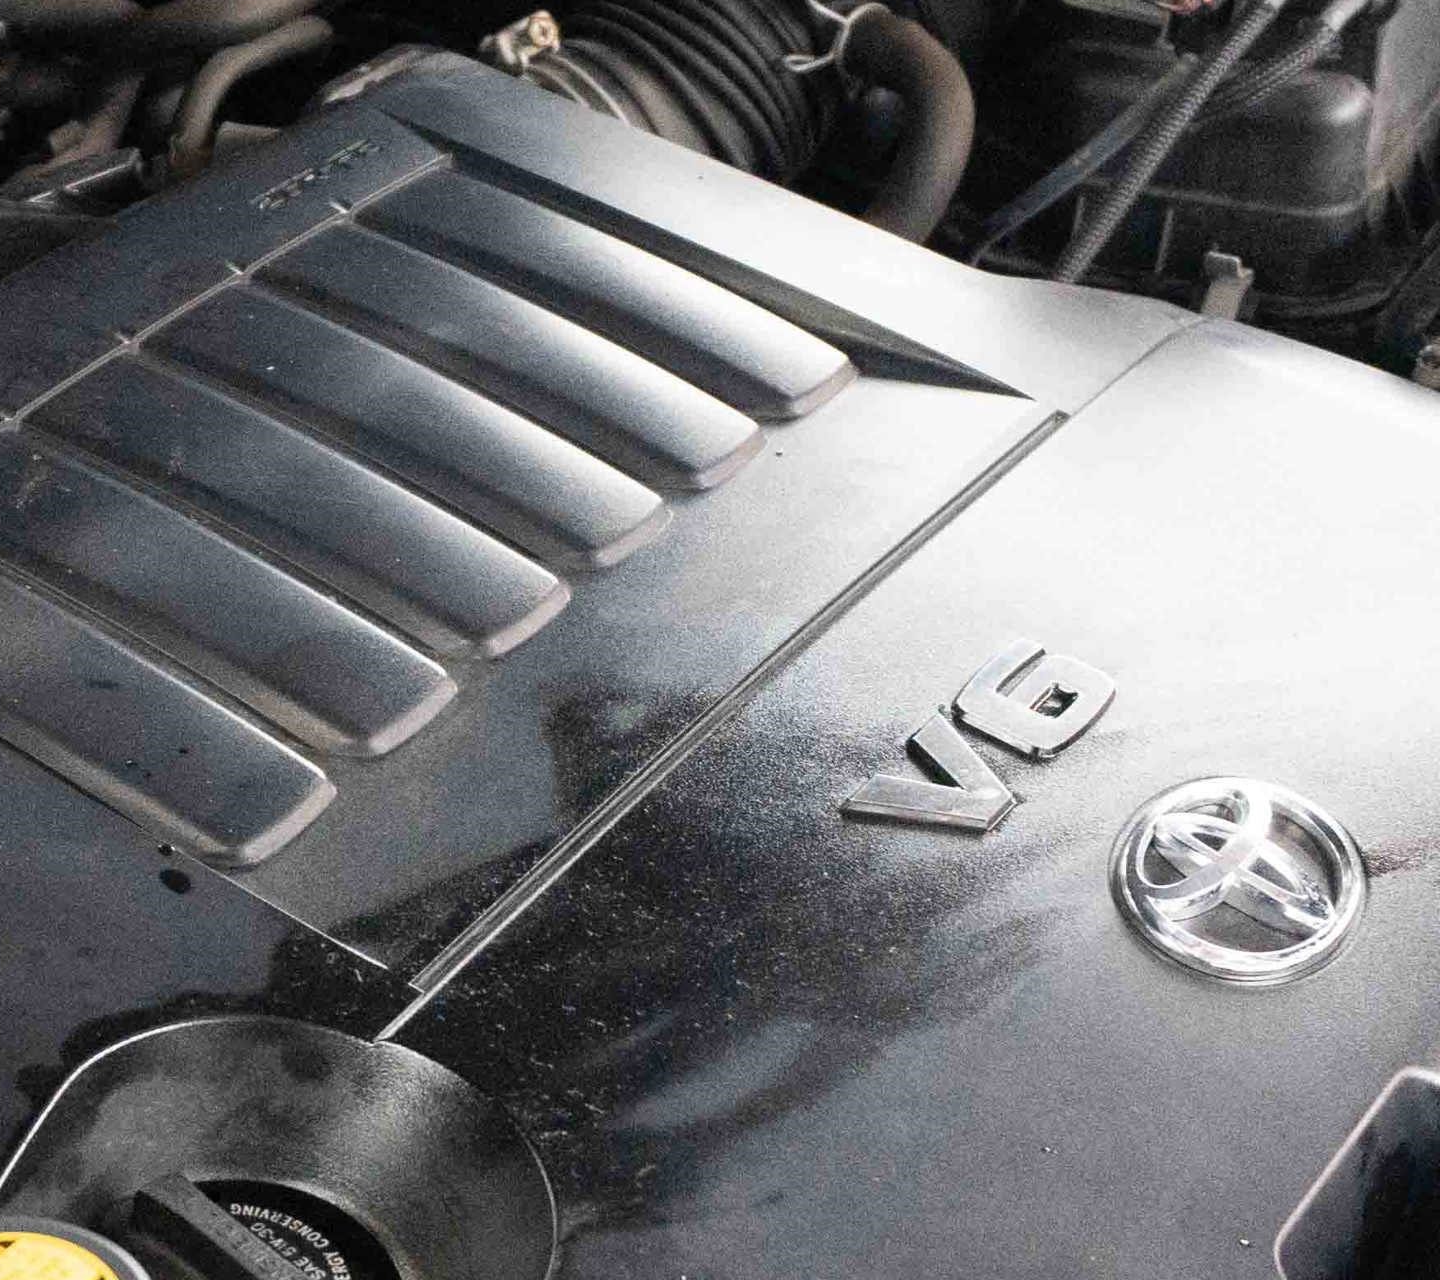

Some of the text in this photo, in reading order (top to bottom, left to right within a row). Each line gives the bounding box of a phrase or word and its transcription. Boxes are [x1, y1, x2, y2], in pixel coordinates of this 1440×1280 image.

[841, 639, 1116, 833] V6
[229, 1203, 329, 1248] CONSERVING
[250, 1223, 296, 1256] 5W-30
[295, 1257, 326, 1280] SAE
